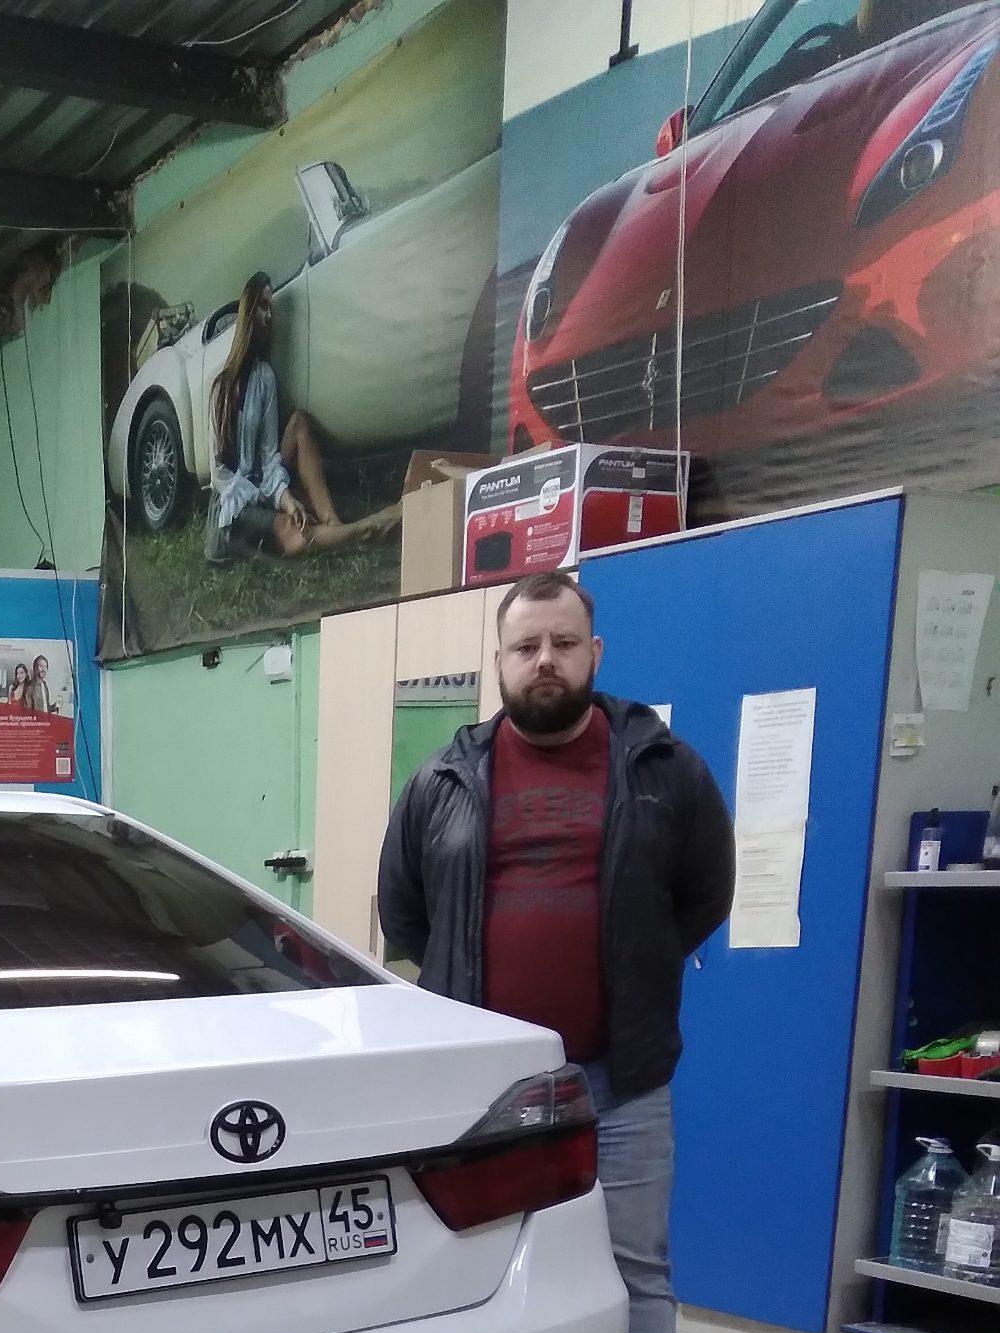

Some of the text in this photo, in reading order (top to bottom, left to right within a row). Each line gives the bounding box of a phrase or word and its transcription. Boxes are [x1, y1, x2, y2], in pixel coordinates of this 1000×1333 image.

[598, 459, 635, 468] PANTUM
[479, 475, 521, 495] PANTUM
[328, 1187, 374, 1233] 45
[328, 1234, 362, 1253] RUS
